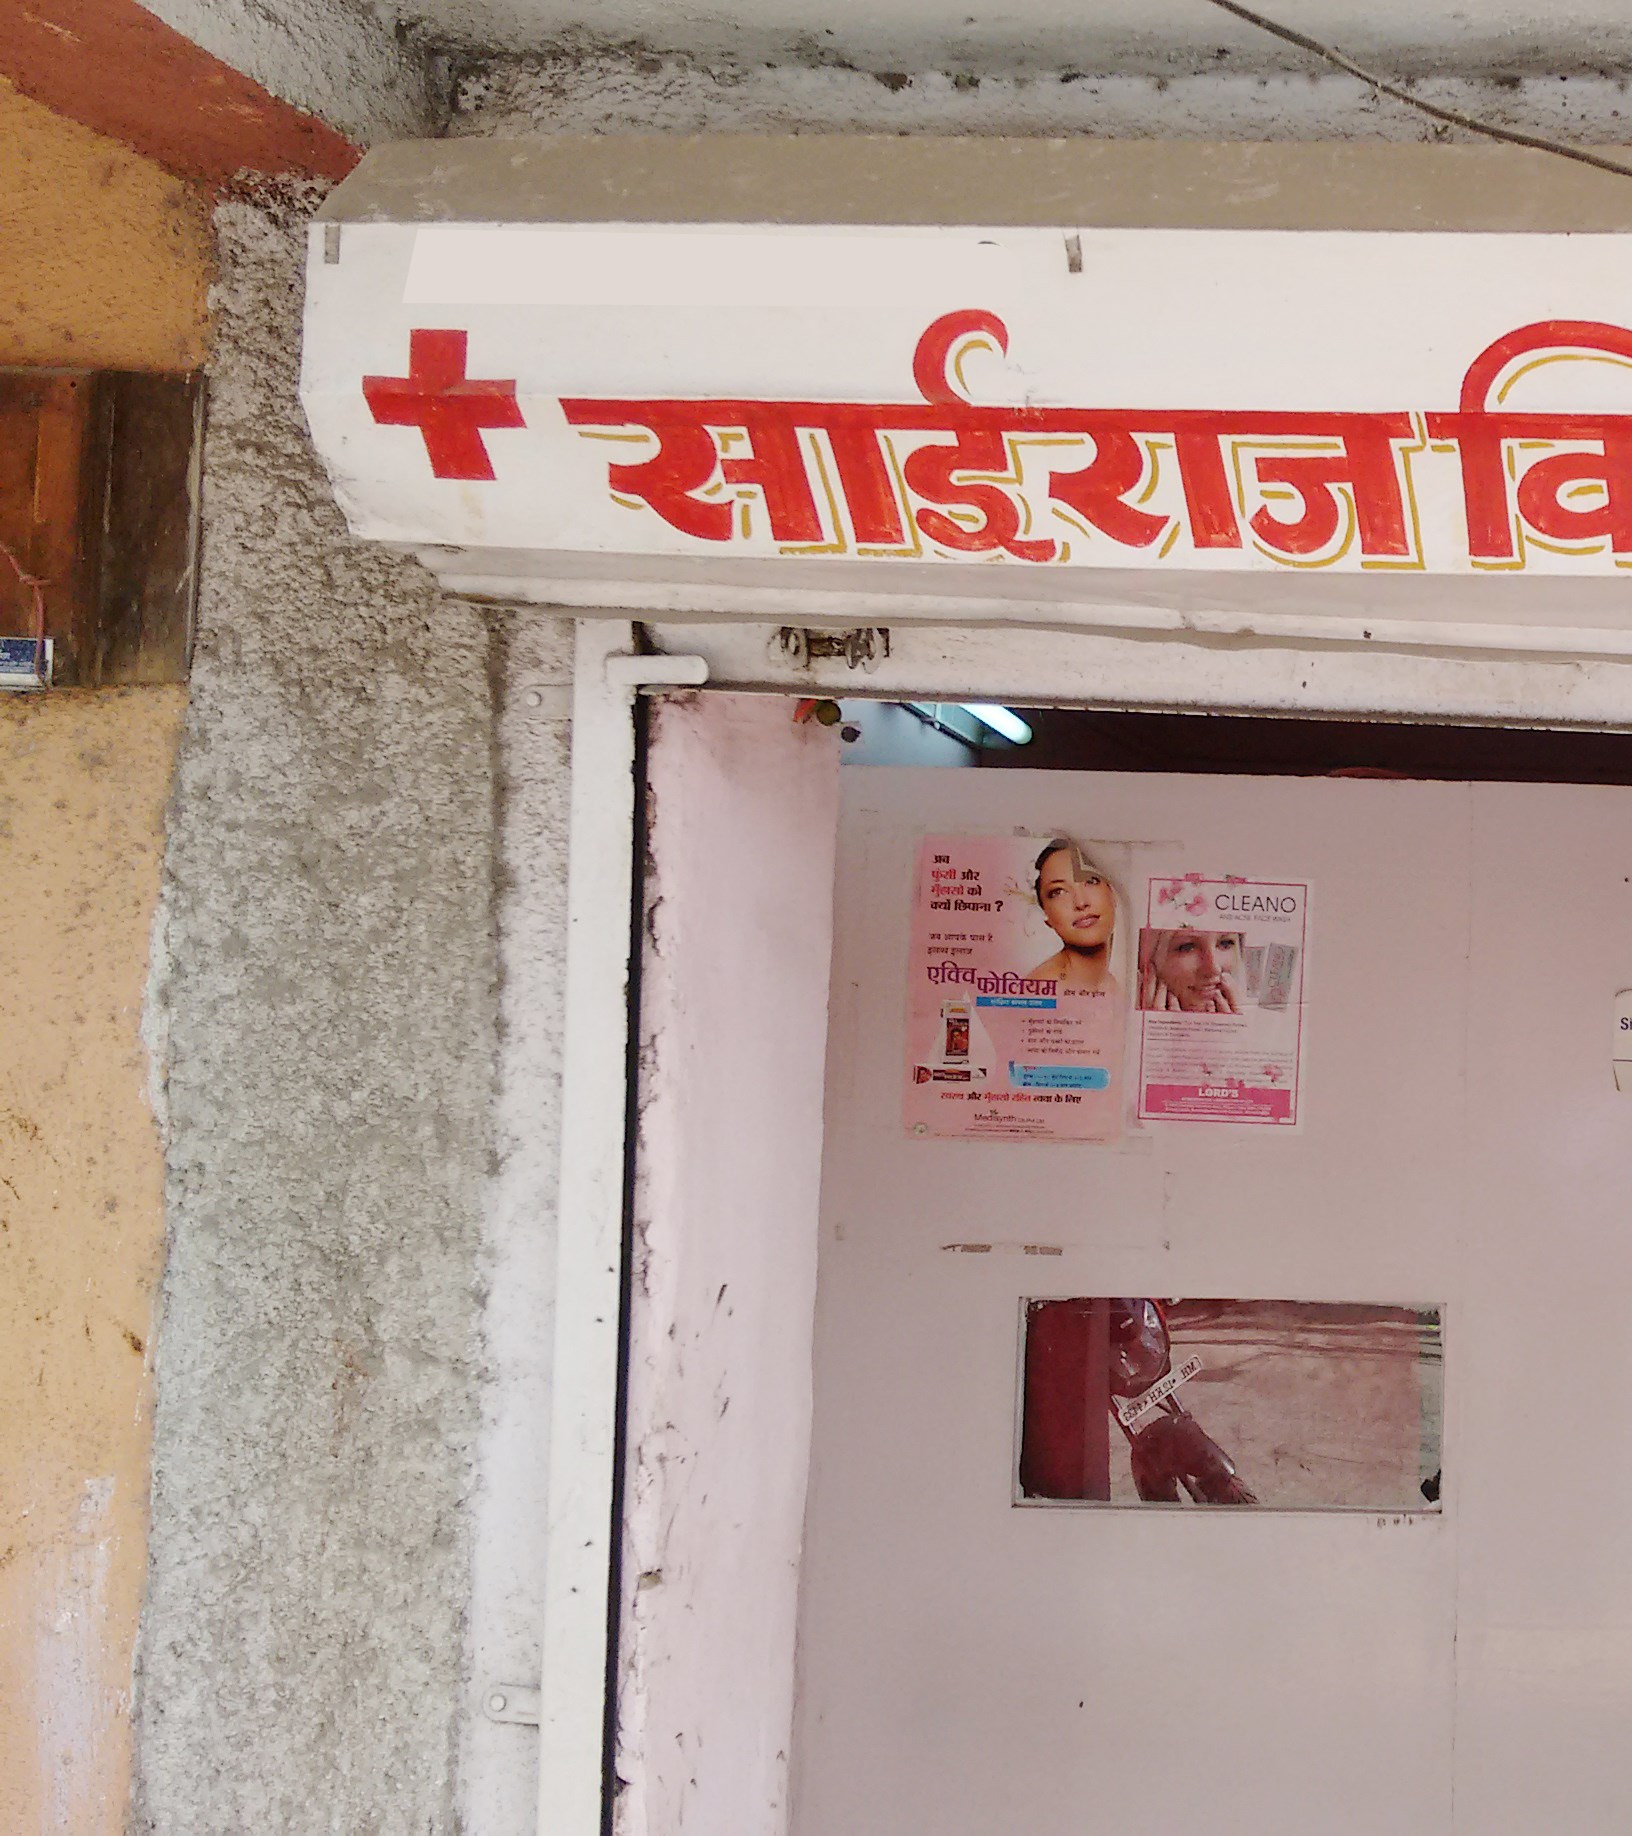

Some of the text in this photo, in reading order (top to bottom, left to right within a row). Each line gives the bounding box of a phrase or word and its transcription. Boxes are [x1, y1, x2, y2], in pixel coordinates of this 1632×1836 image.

[557, 308, 1425, 570] साईराज
[961, 869, 980, 881] और
[967, 885, 982, 896] को
[1215, 894, 1296, 913] CLEANO
[977, 971, 1058, 996] फोलियम
[1198, 1088, 1239, 1098] LORD'S
